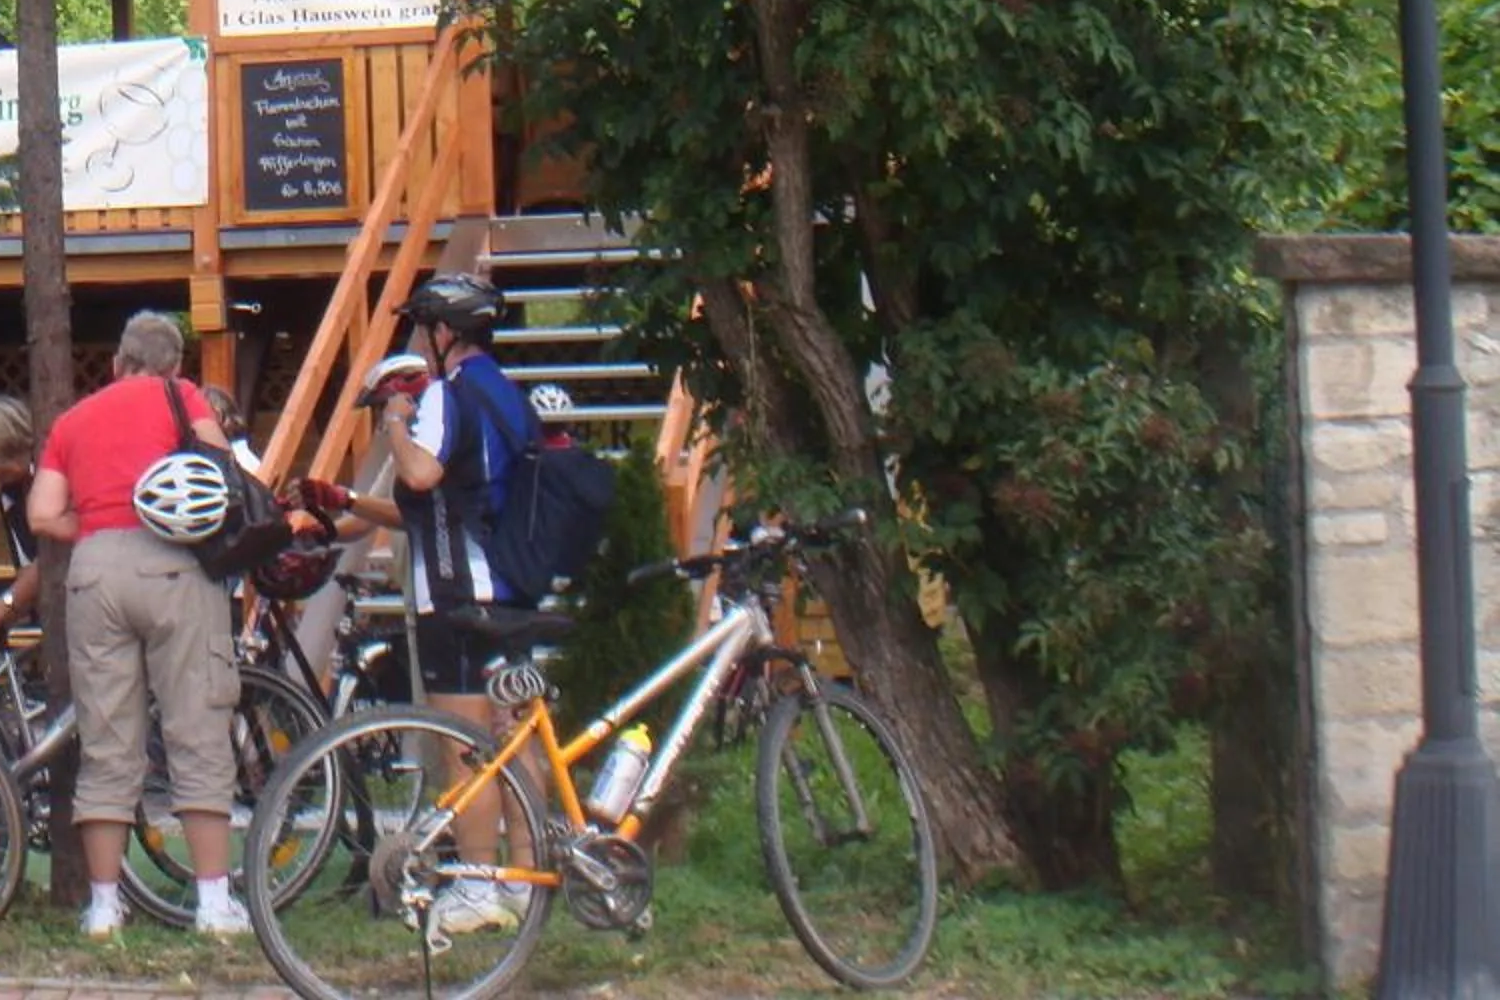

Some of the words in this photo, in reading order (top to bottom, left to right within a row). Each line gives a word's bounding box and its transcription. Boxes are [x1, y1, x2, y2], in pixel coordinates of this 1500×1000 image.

[237, 9, 286, 27] Glas
[292, 4, 392, 24] Hauswein
[399, 1, 440, 21] grat
